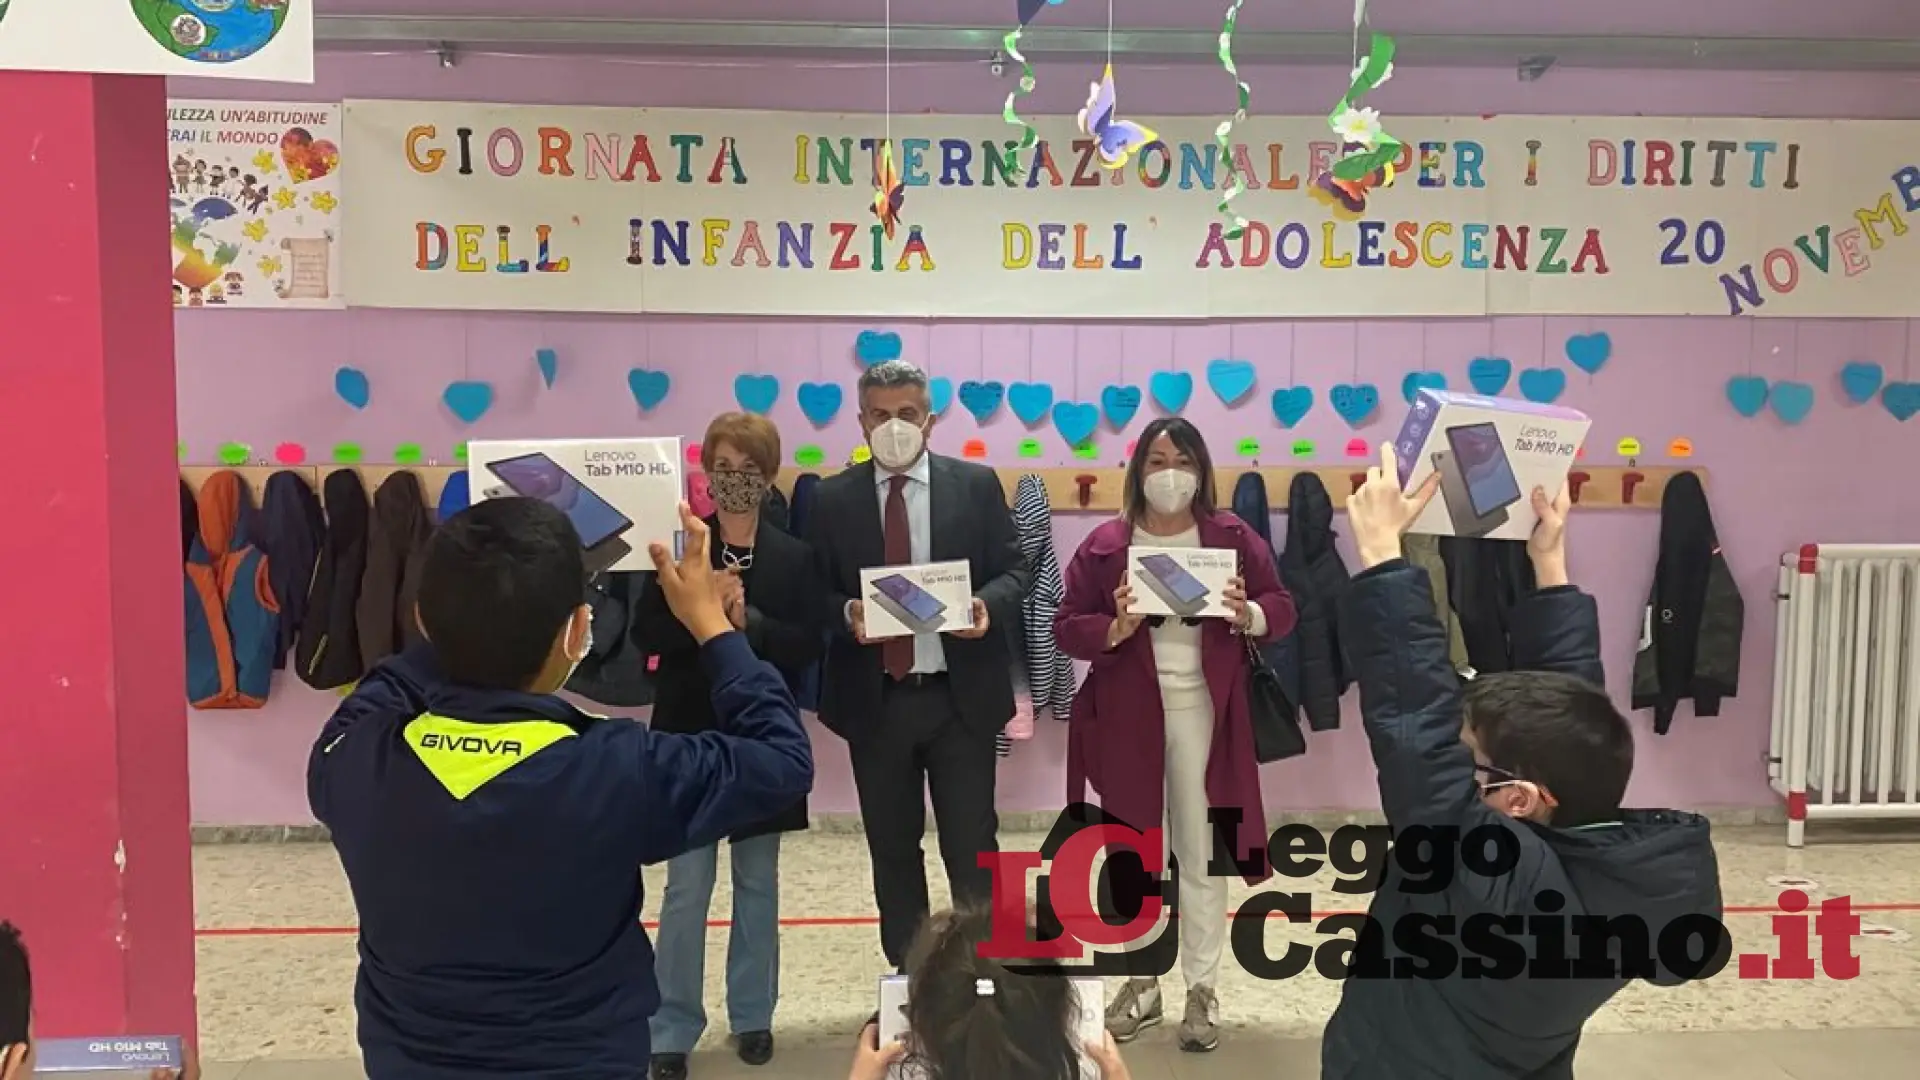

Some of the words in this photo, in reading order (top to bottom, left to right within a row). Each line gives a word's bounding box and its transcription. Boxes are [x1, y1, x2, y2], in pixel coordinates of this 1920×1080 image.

[220, 110, 329, 125] UN'ABITUDINE
[167, 129, 196, 142] RAI
[216, 130, 279, 145] MONDO
[405, 125, 748, 185] GIORNATA
[1524, 140, 1540, 186] I
[1587, 140, 1800, 190] DIRITTI
[627, 218, 935, 272] INFANZIA
[1195, 220, 1609, 274] ADOLESCENZA
[1659, 218, 1725, 265] 20
[1515, 438, 1533, 451] Tab
[1556, 443, 1575, 456] HD
[584, 449, 636, 462] Lenovo
[585, 464, 612, 477] Tab
[616, 463, 645, 476] M10
[420, 734, 522, 757] GIVOVA
[88, 1041, 113, 1053] HD
